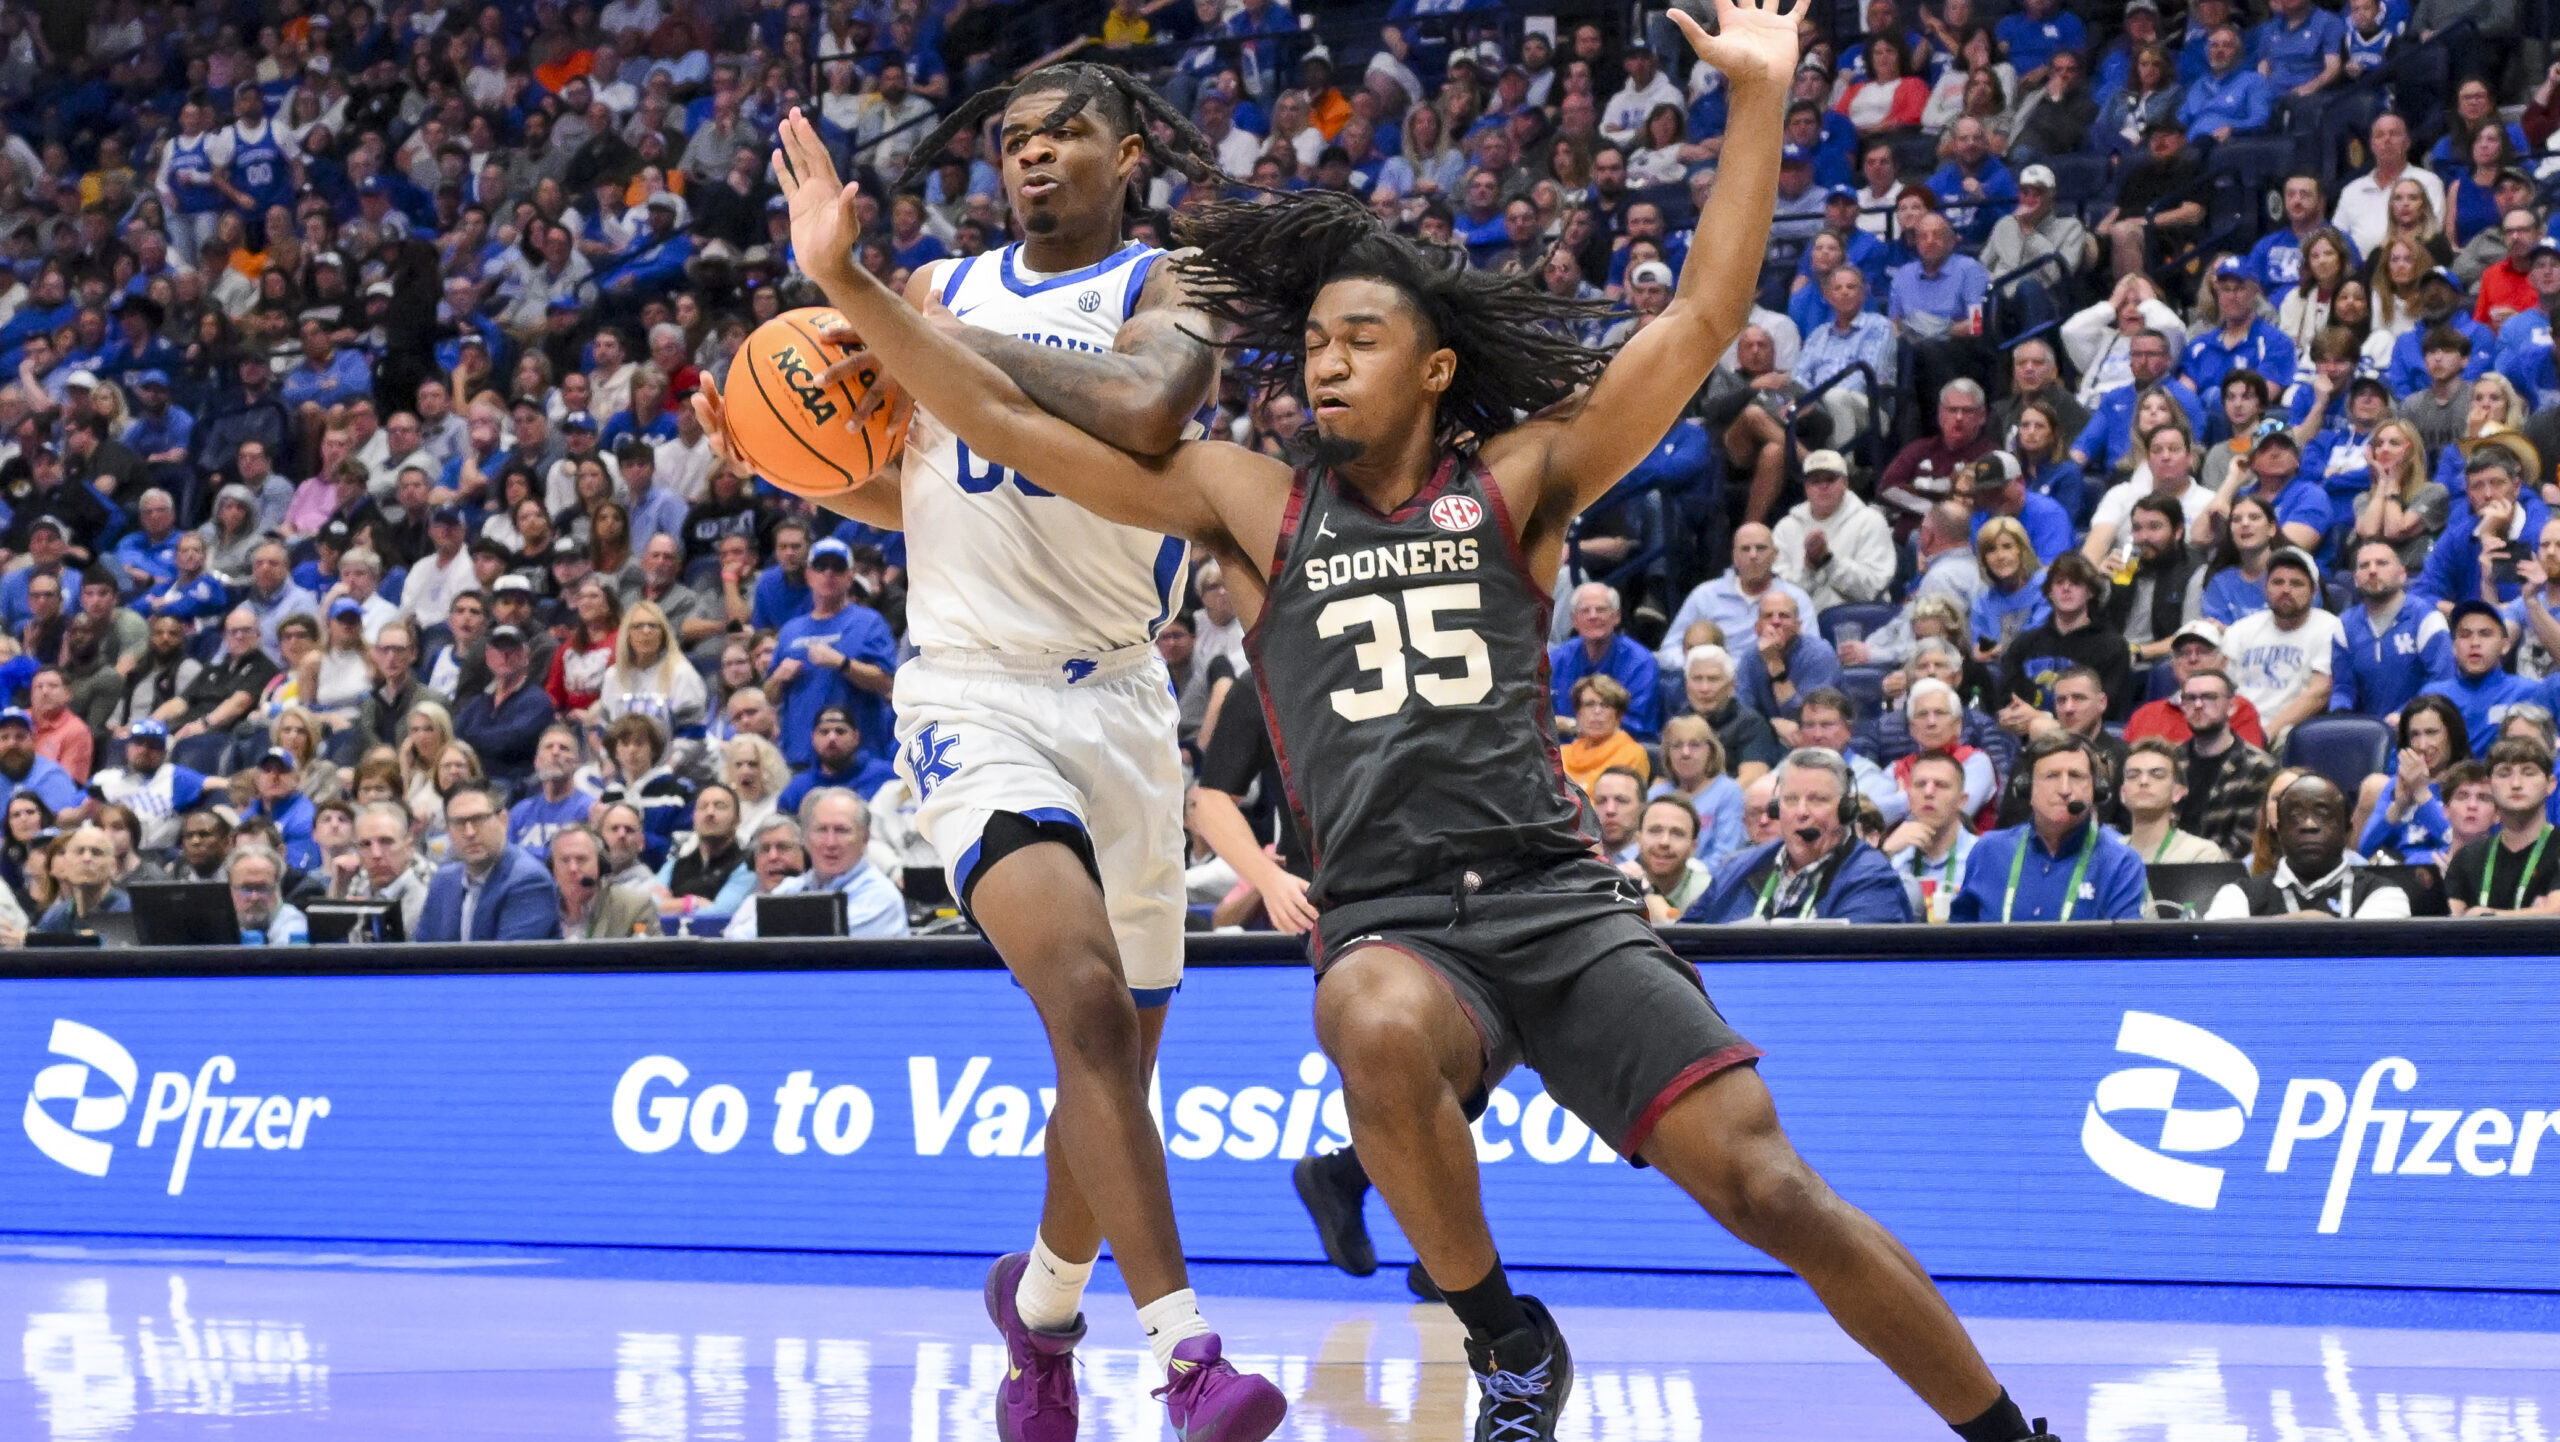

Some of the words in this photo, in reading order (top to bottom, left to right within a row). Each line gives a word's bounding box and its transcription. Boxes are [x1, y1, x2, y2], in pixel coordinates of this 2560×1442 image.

[1079, 291, 1101, 312] SEC
[771, 346, 837, 426] NCAA
[1431, 496, 1481, 530] SEC
[1305, 538, 1479, 591] SOONERS
[1316, 583, 1493, 722] 35
[137, 1055, 331, 1196] Pfizer
[612, 1054, 749, 1154] Go
[773, 1070, 875, 1155] to
[2265, 1056, 2560, 1234] Pfizer
